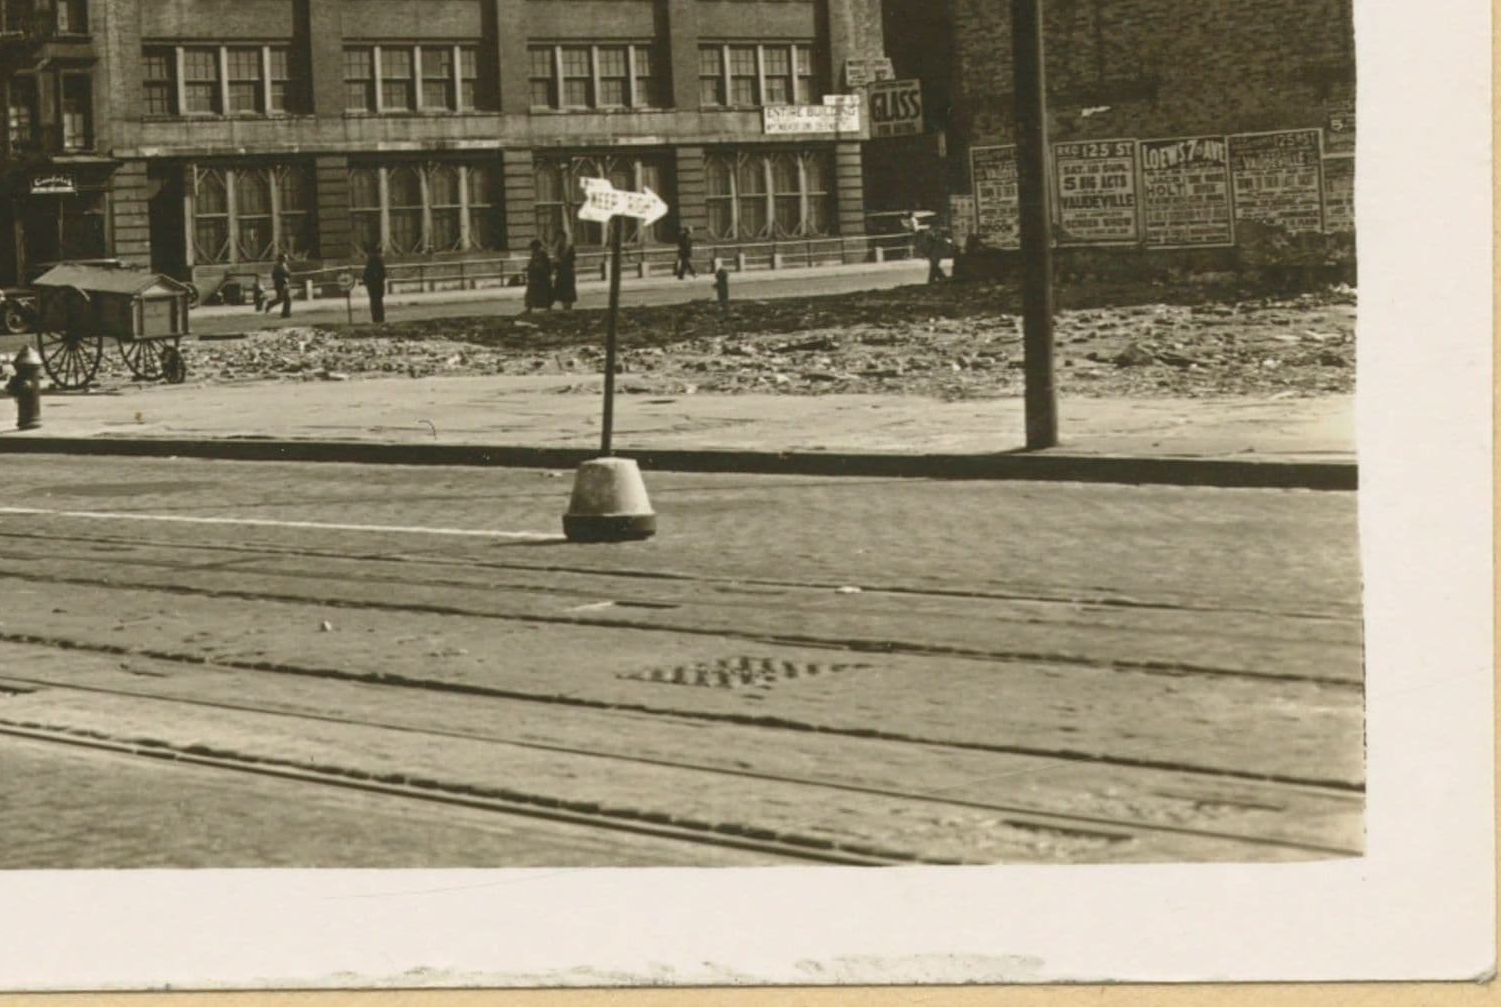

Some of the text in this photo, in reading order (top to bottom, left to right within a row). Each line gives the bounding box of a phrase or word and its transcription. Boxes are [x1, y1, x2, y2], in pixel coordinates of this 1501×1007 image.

[870, 89, 920, 122] GLASS
[1083, 144, 1109, 158] 125
[1116, 142, 1133, 156] ST
[1079, 176, 1096, 190] BIG
[1101, 174, 1128, 188] ACTS
[1147, 184, 1184, 196] HOLT
[591, 192, 618, 210] KEEP
[1061, 194, 1135, 210] VAUDEVILLE
